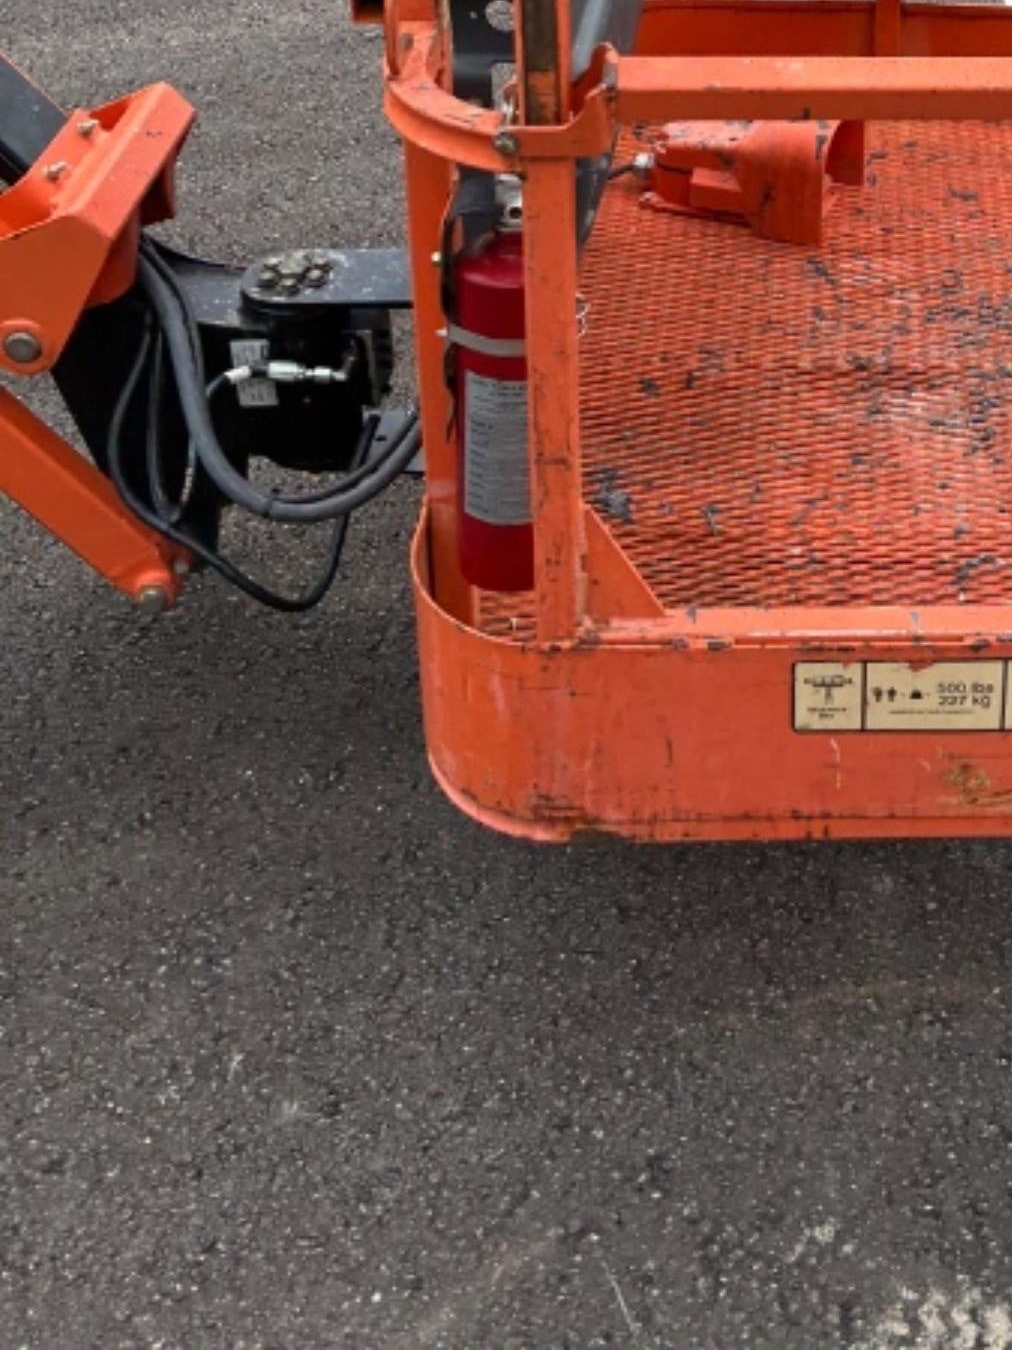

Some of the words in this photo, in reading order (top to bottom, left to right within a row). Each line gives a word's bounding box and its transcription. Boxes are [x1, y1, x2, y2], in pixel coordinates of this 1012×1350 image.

[937, 681, 967, 694] 500
[937, 695, 967, 707] 227
[971, 695, 991, 709] kg
